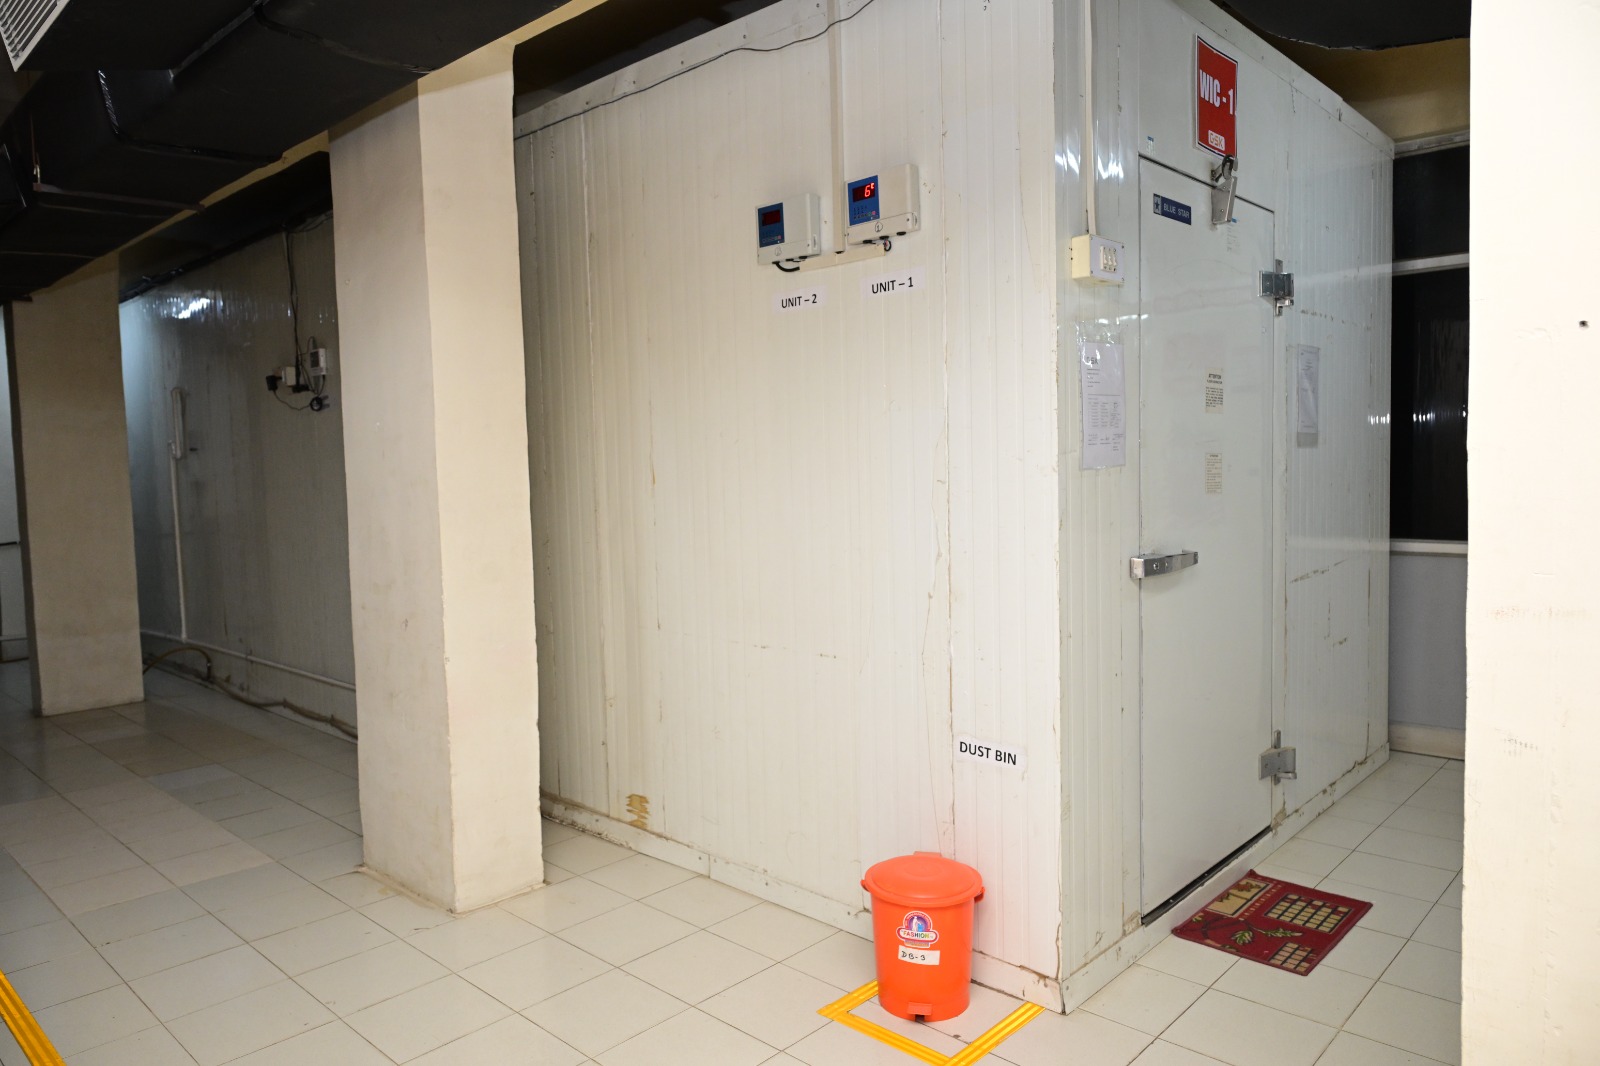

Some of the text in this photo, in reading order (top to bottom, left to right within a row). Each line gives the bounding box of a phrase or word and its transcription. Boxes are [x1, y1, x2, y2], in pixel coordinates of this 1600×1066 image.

[1200, 69, 1220, 107] WIC
[1209, 132, 1224, 149] GSK
[1163, 202, 1190, 219] BLUE STAR
[871, 279, 897, 294] UNIT
[908, 276, 914, 288] 1
[781, 296, 802, 309] UNIT
[812, 294, 818, 304] 2
[959, 741, 1017, 766] DUST BIN
[903, 930, 929, 939] FASHION
